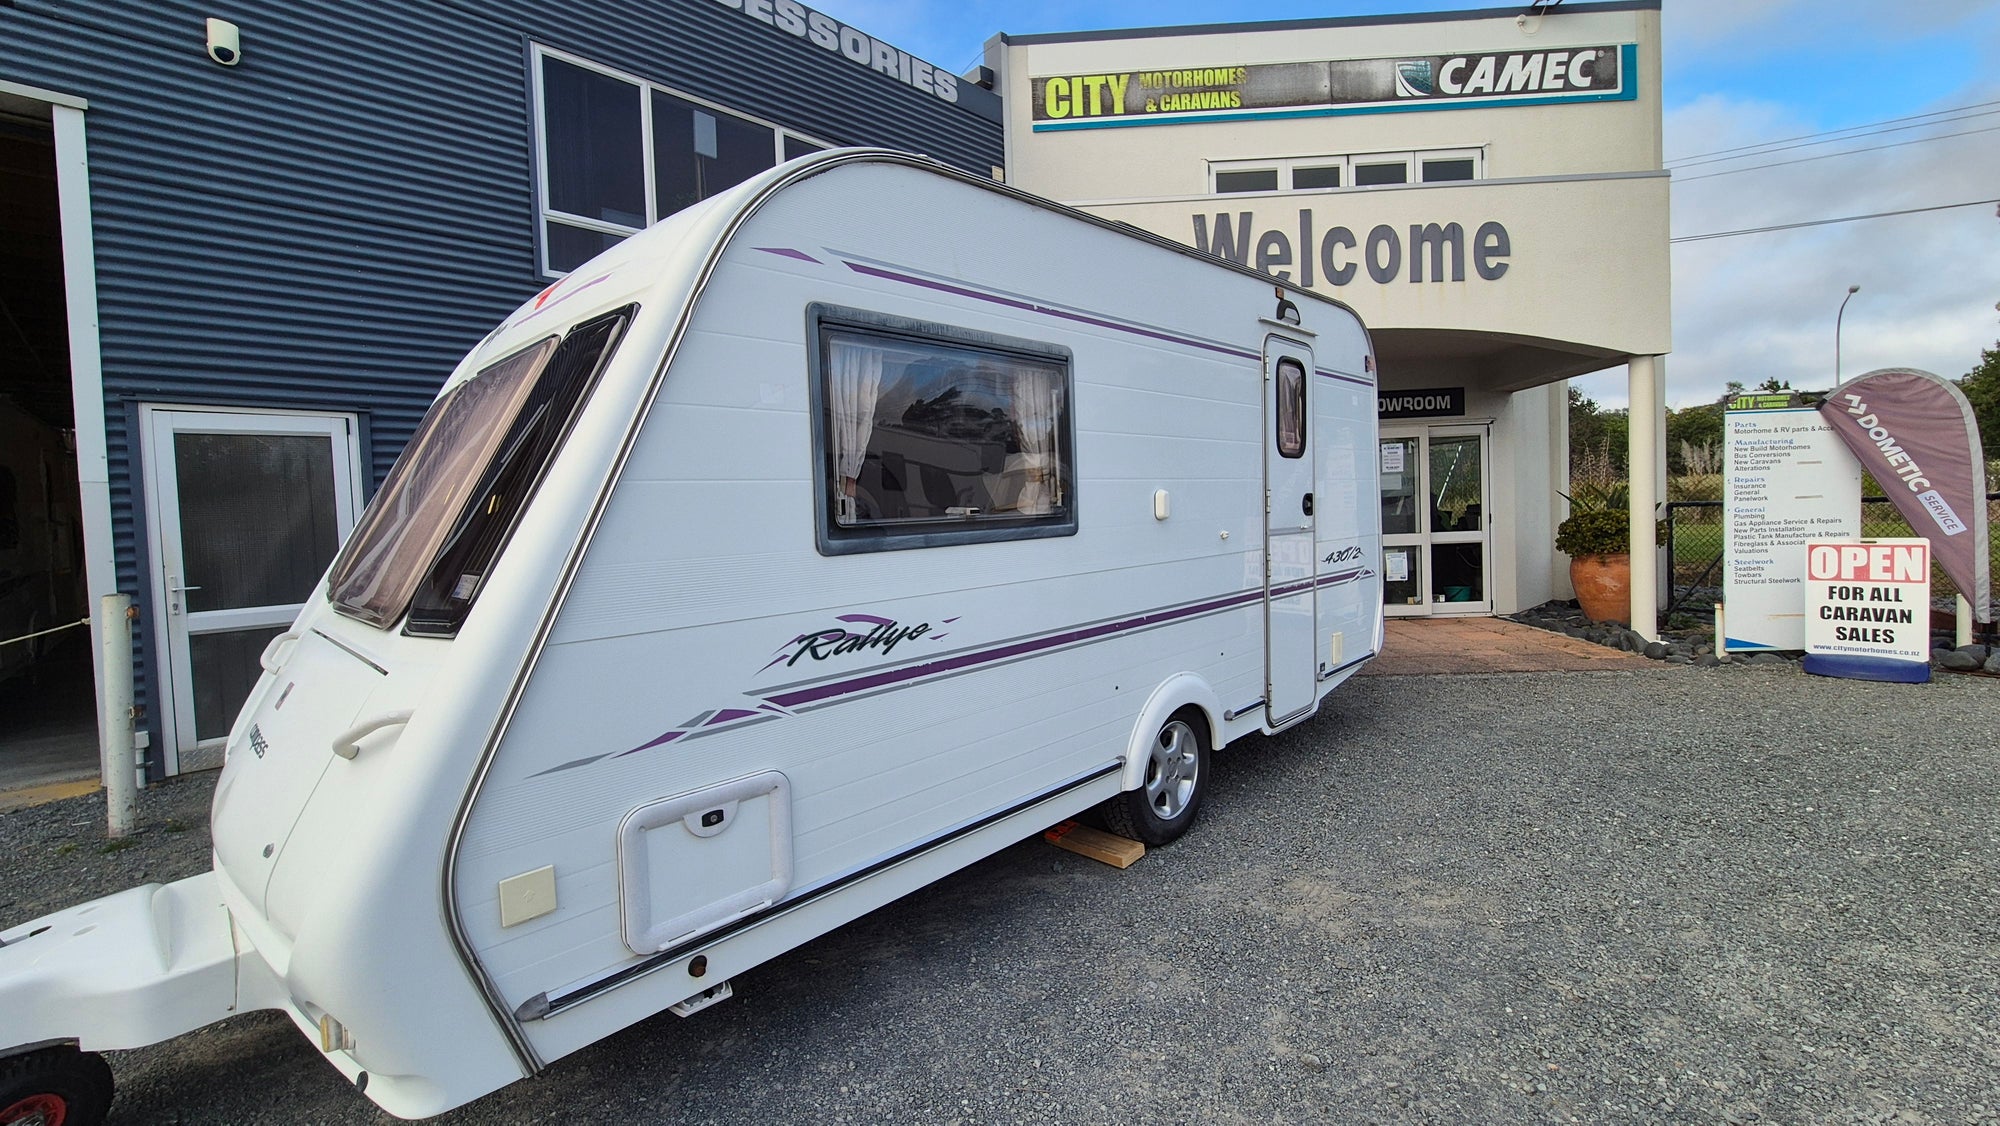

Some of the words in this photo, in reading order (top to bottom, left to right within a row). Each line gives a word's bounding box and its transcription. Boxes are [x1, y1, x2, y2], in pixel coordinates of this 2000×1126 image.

[716, 0, 958, 103] ESSORIES
[1139, 67, 1246, 90] MOTORHOMES
[1439, 50, 1597, 95] CAMEC
[1045, 74, 1130, 119] CITY
[1145, 97, 1157, 113] &
[1159, 90, 1241, 112] CARAVANS
[1192, 208, 1511, 287] Welcome
[1792, 426, 1808, 434] parts
[1734, 438, 1794, 446] Manufacturing
[1856, 413, 1931, 492] DOMETIC
[1816, 517, 1842, 525] Repairs
[1924, 495, 1959, 530] SERVICE
[1734, 540, 1768, 548] Fibreglass
[1775, 531, 1816, 539] Manufacture
[1824, 530, 1850, 538] Repairs
[1811, 546, 1923, 581] OPEN
[1828, 586, 1864, 601] FOR
[1870, 587, 1903, 603] ALL
[1820, 605, 1912, 624] CARAVAN
[786, 621, 932, 667] Rallye
[1835, 626, 1895, 644] SALES
[1813, 644, 1920, 657] www.citymotorhomes.co.nz
